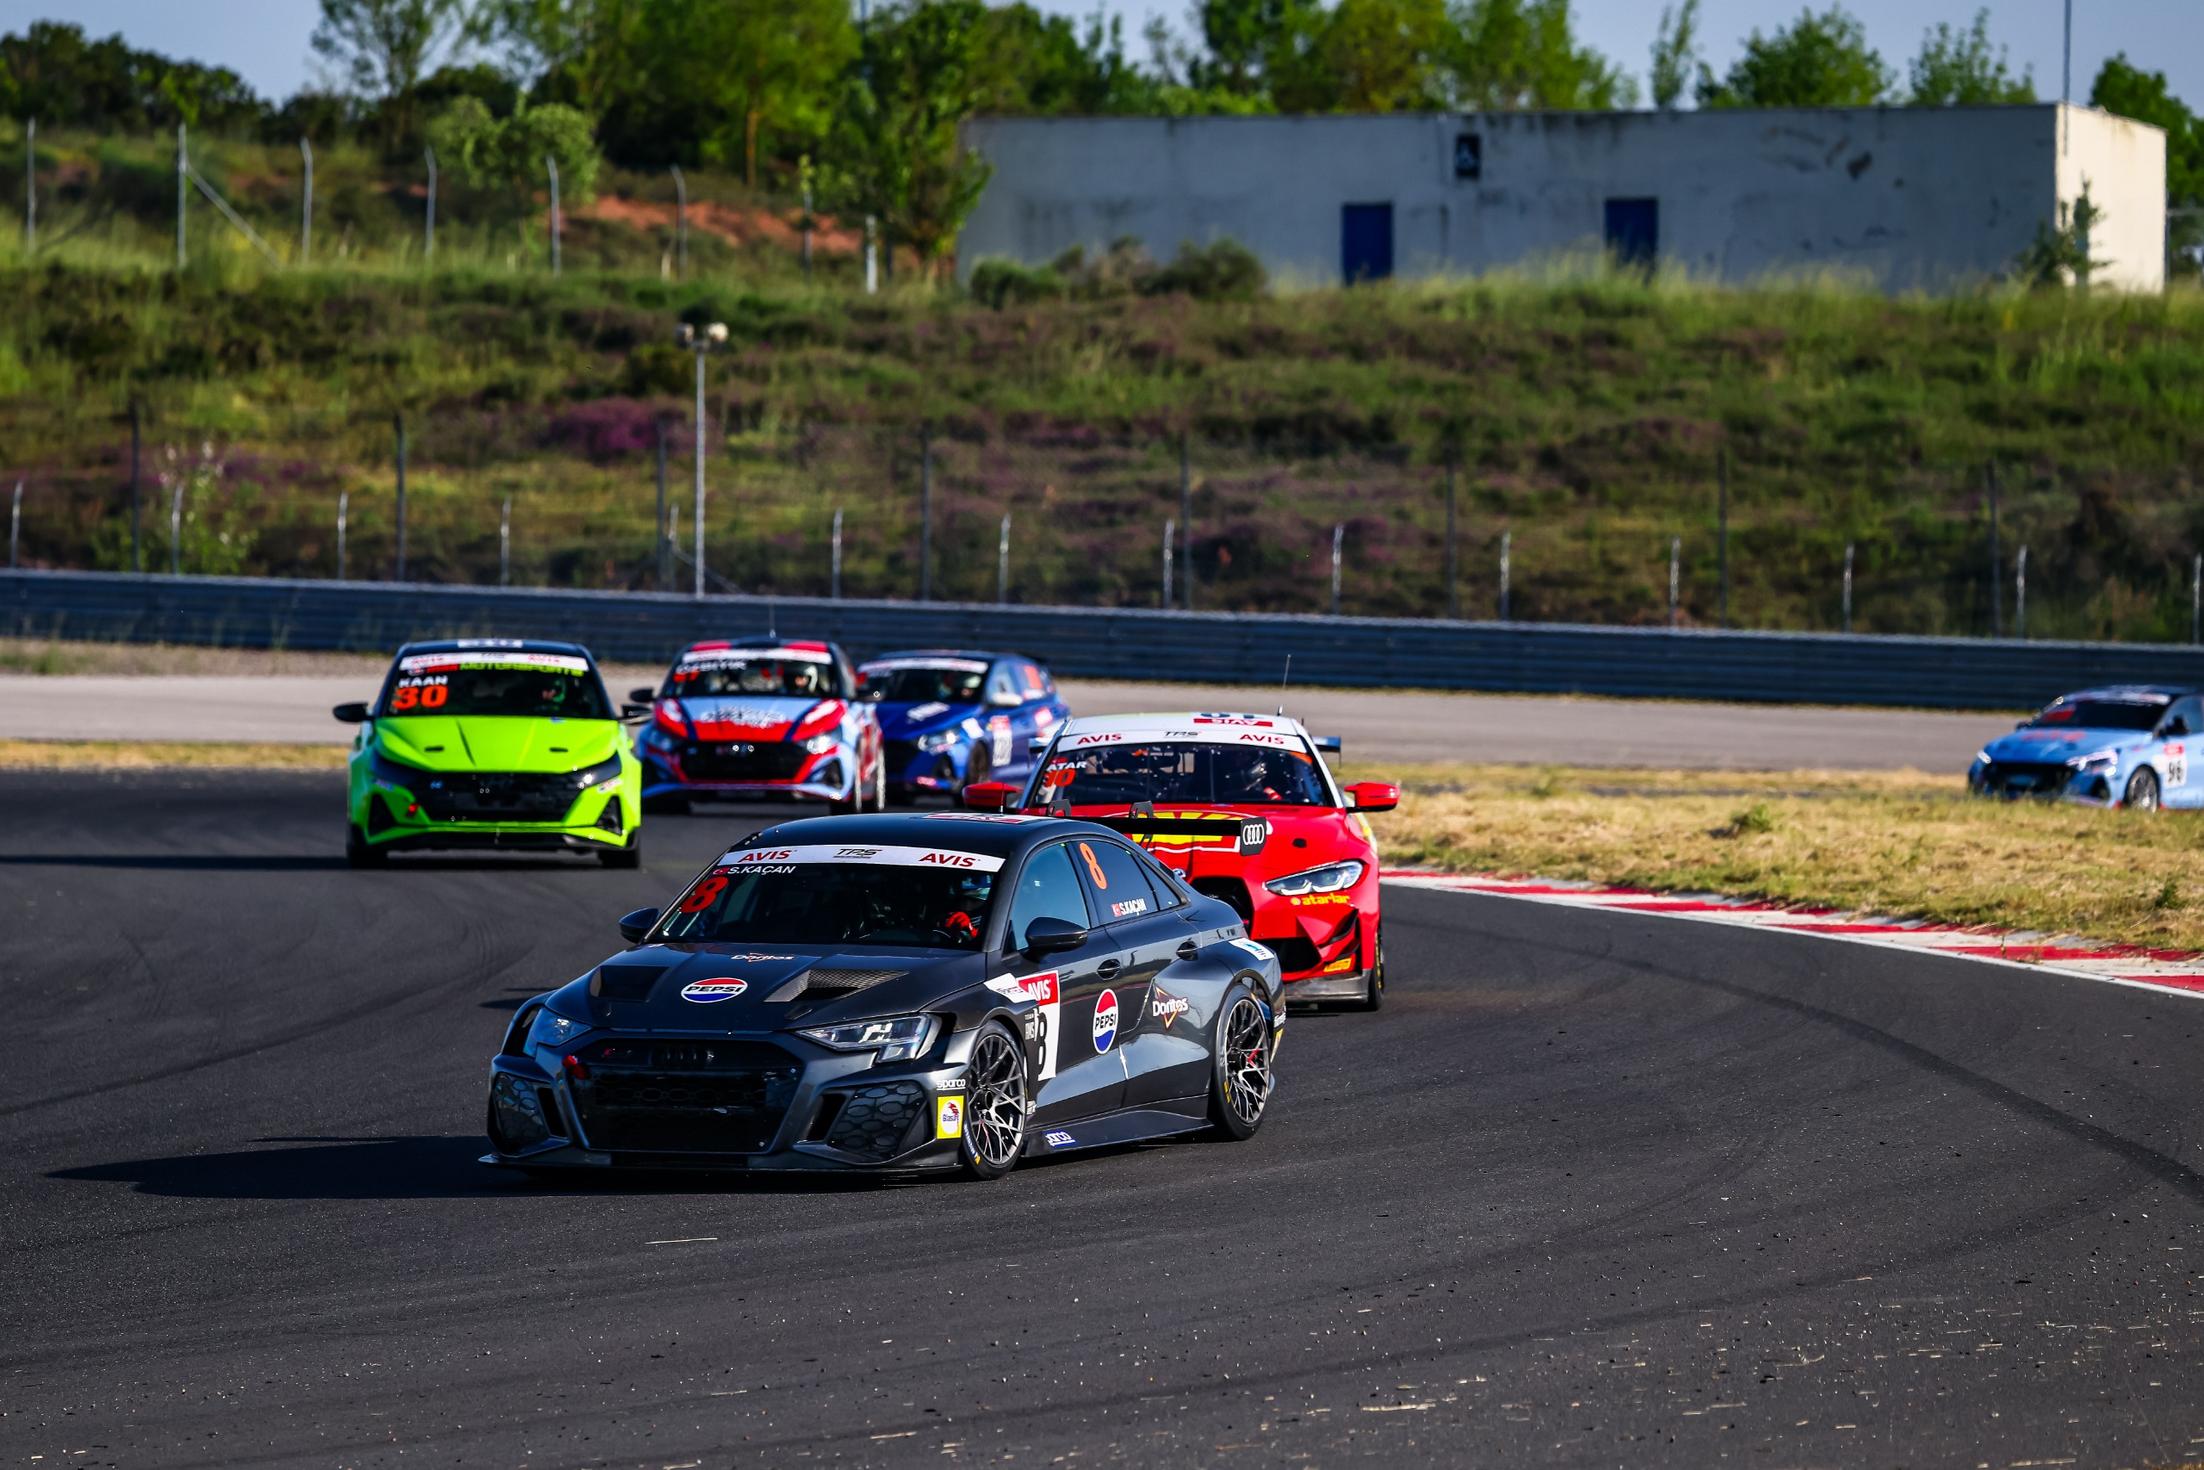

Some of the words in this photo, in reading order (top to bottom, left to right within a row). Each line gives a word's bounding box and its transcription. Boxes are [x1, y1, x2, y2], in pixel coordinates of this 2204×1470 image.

[398, 676, 449, 688] KAAN
[392, 684, 449, 710] 30
[1077, 734, 1122, 745] AVIS
[1240, 734, 1285, 745] AVIS
[738, 850, 793, 863] AVIS
[919, 853, 976, 868] AVIS
[1080, 843, 1107, 889] 8
[727, 866, 797, 876] S.KAÇAN
[679, 876, 729, 914] 8
[1027, 979, 1051, 1001] AVIS
[1152, 997, 1189, 1017] Doritos
[1094, 1013, 1117, 1031] PEPSI
[936, 1079, 966, 1090] sparco
